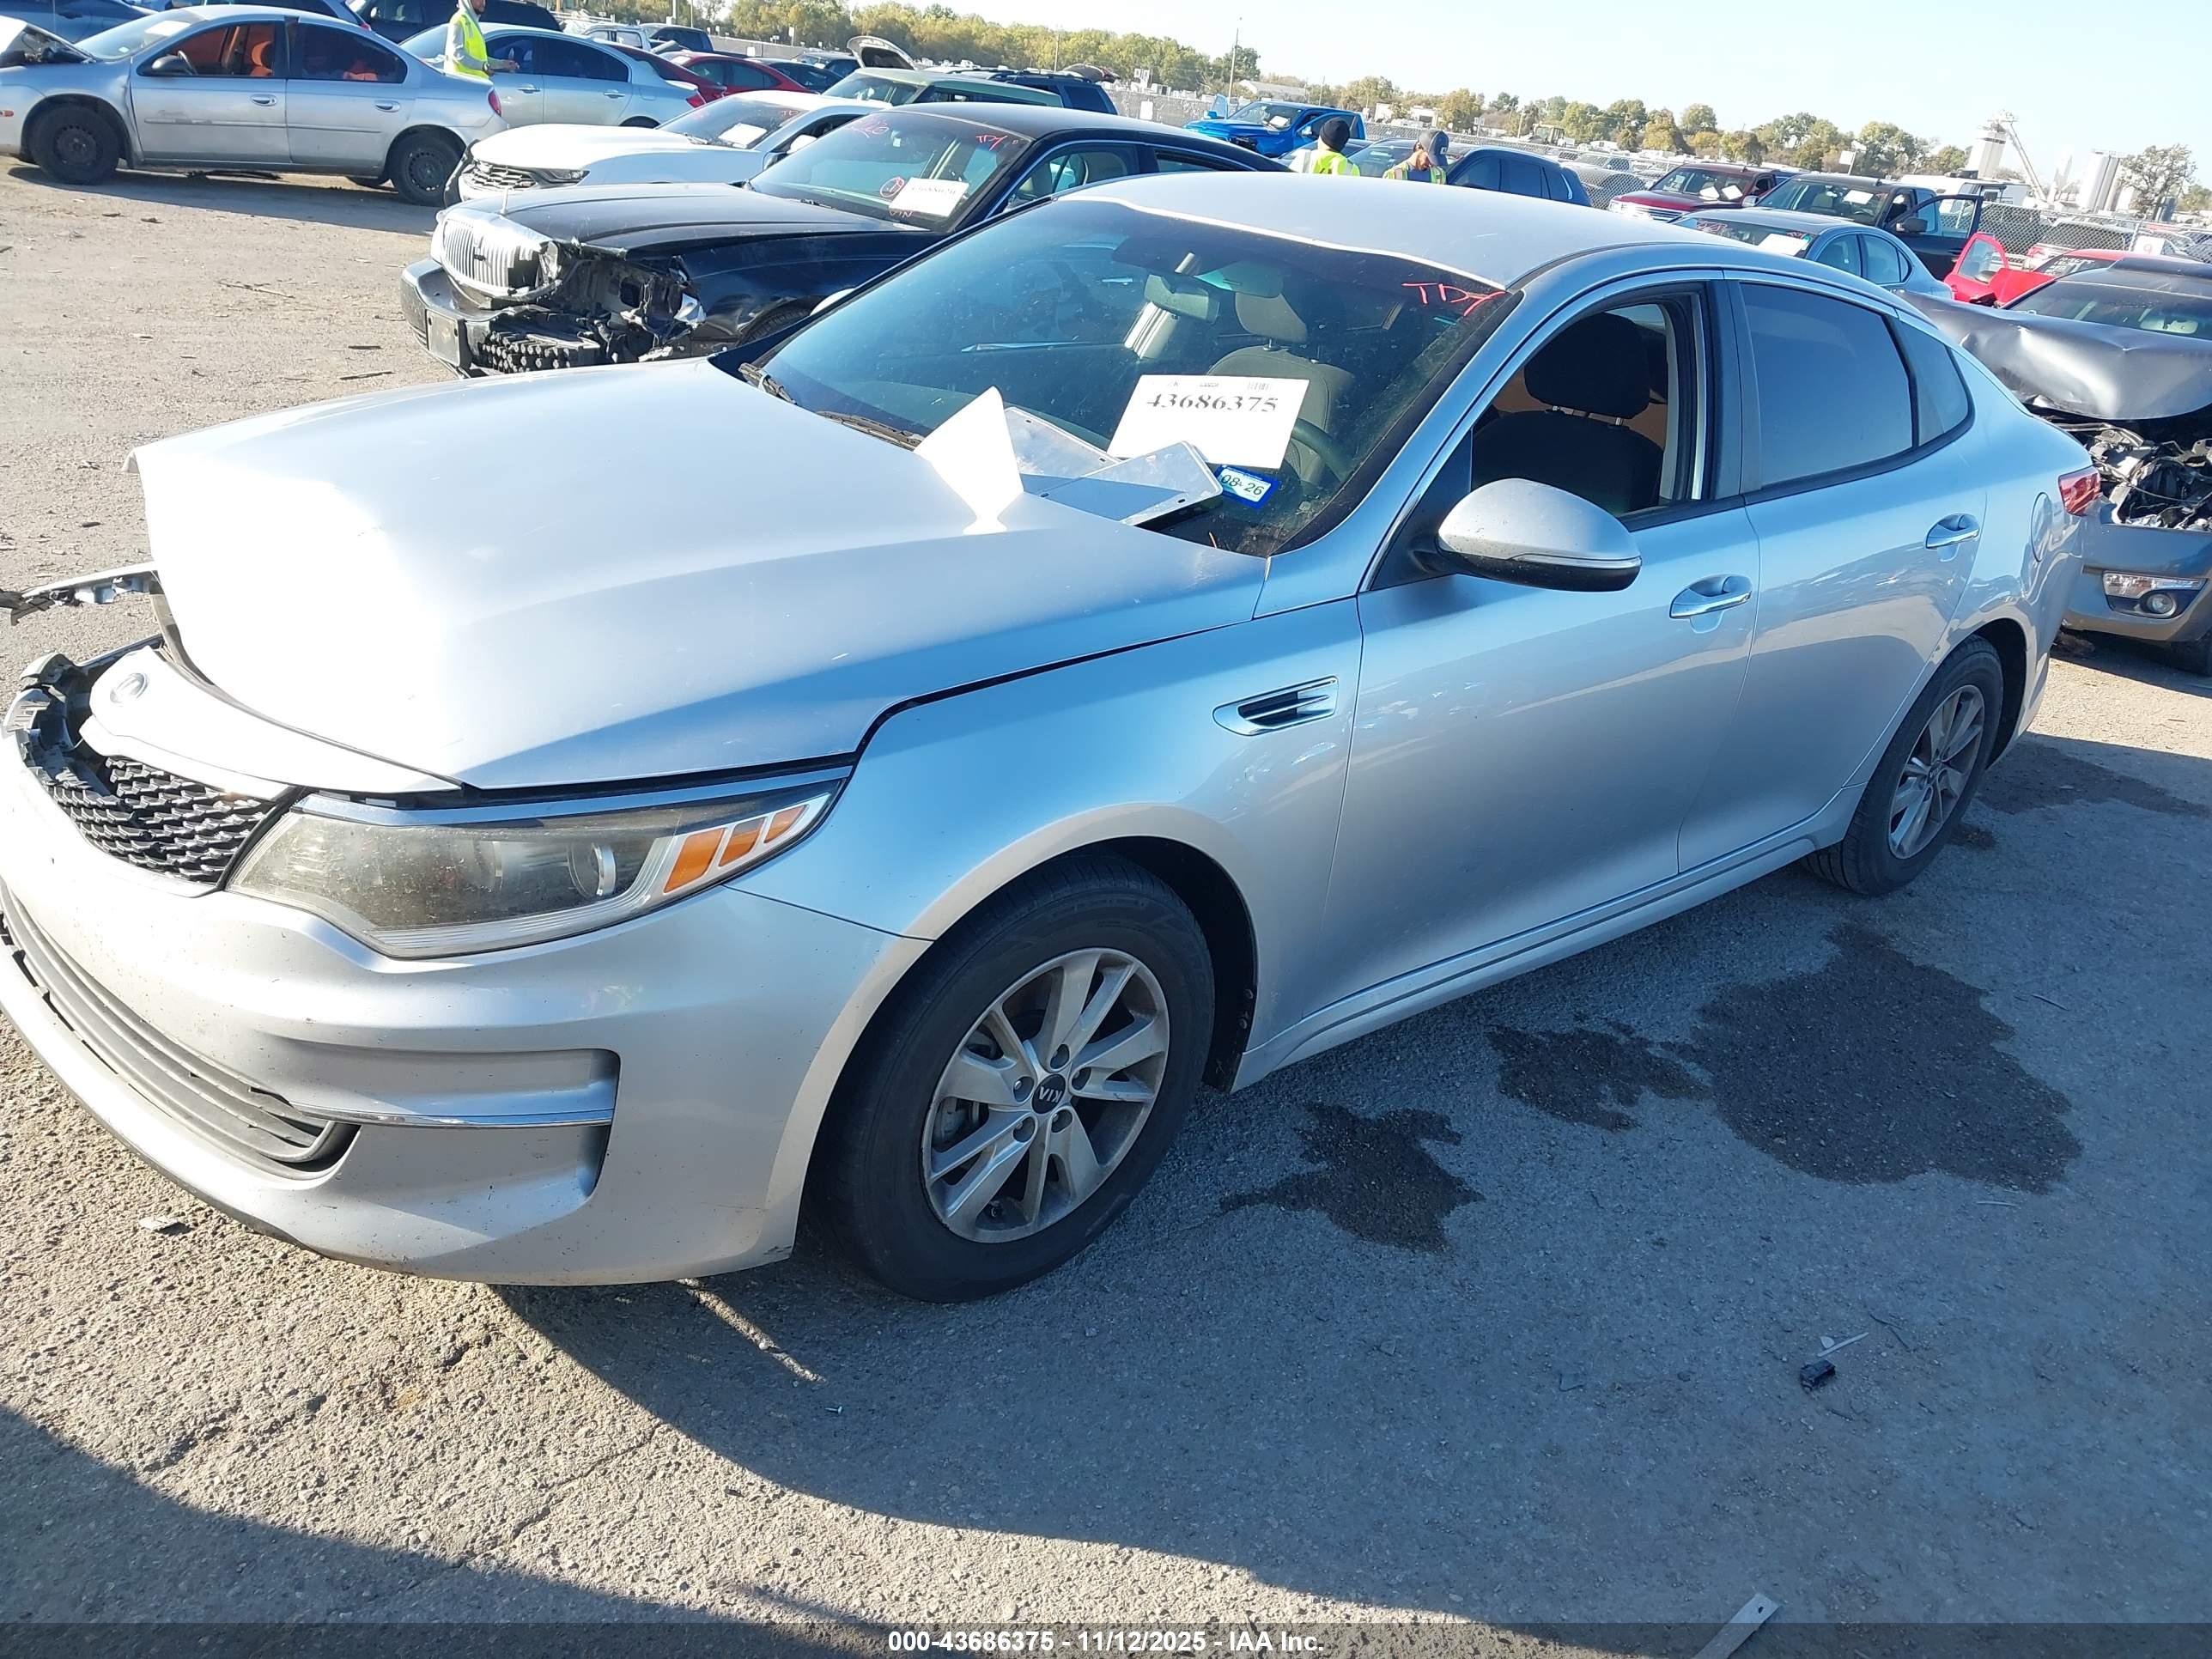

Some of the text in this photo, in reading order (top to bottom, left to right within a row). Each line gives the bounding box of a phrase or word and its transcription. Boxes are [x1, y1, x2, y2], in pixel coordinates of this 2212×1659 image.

[1146, 392, 1279, 412] 43686375
[1220, 474, 1265, 496] 08 26
[1039, 1086, 1063, 1103] KIA
